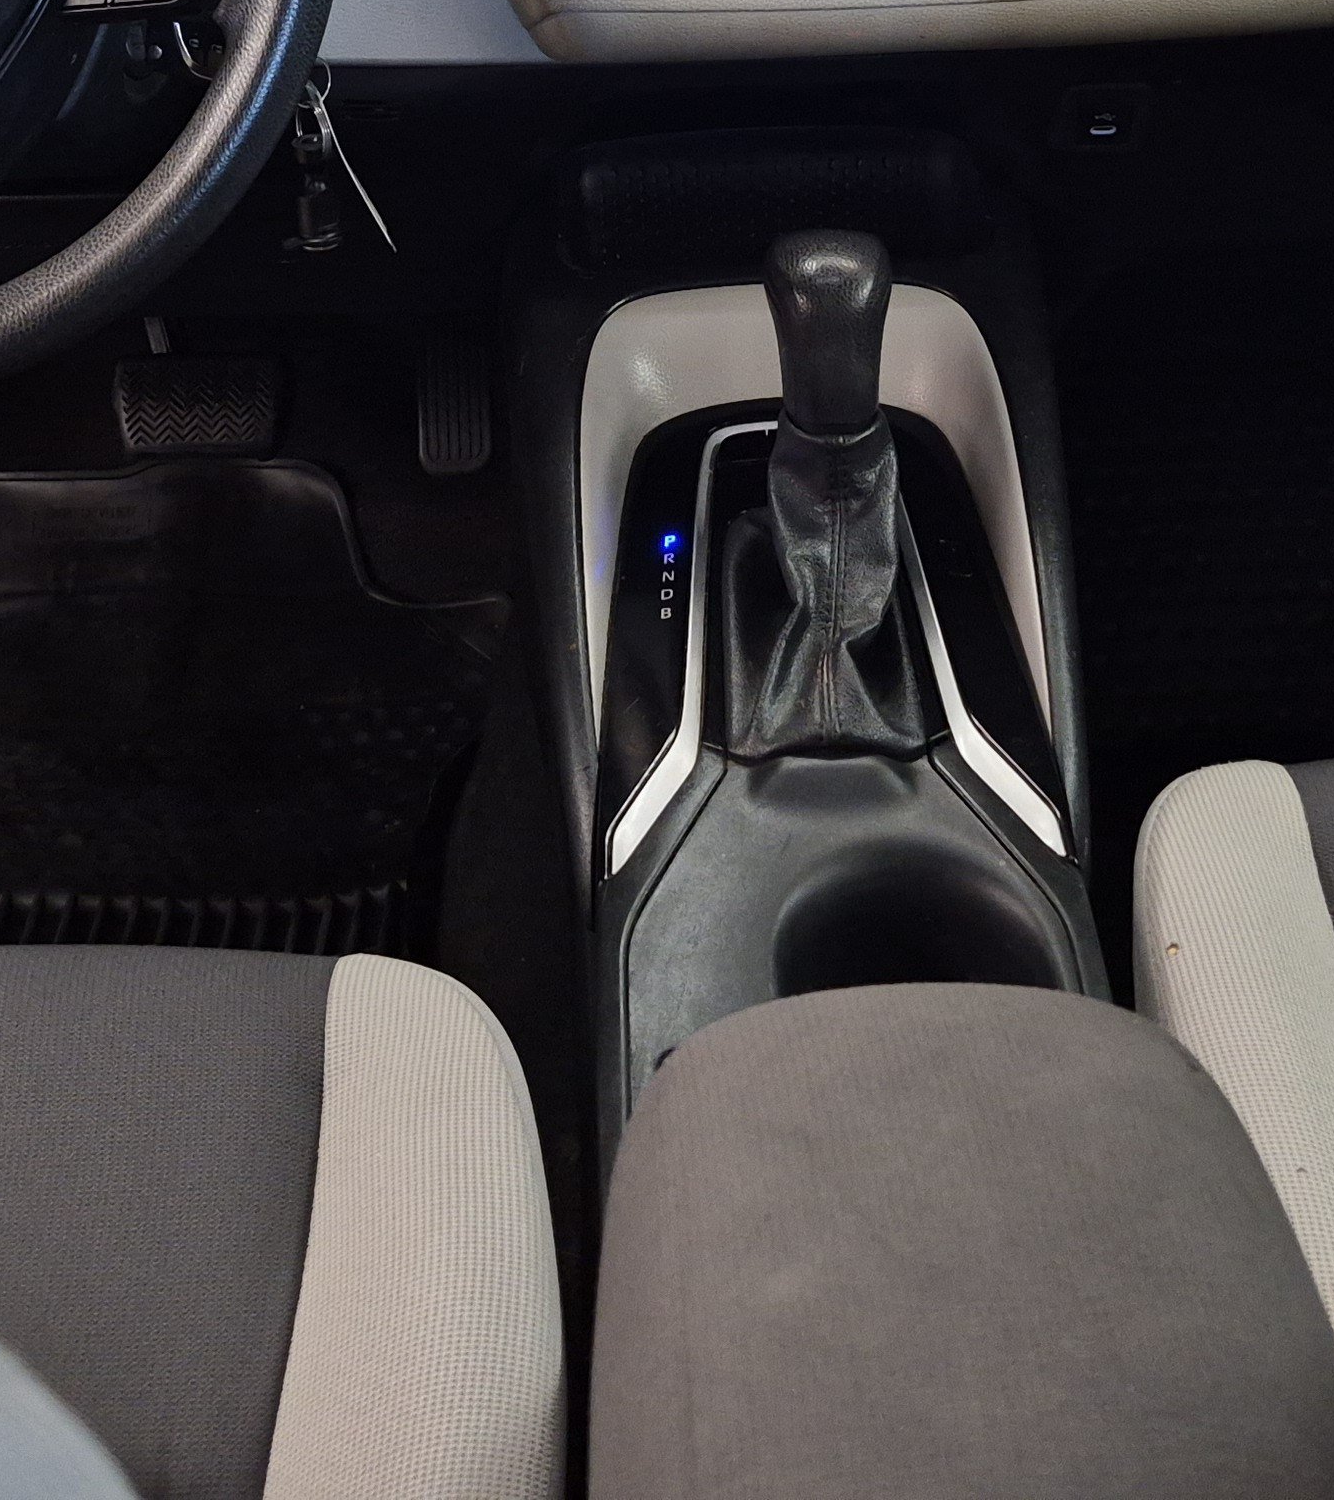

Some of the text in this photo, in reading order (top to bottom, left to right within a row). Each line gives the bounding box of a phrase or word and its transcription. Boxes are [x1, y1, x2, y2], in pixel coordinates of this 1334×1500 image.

[664, 535, 676, 547] P
[664, 553, 675, 564] R
[662, 570, 675, 582] N
[661, 588, 673, 601] D
[661, 607, 672, 620] B
